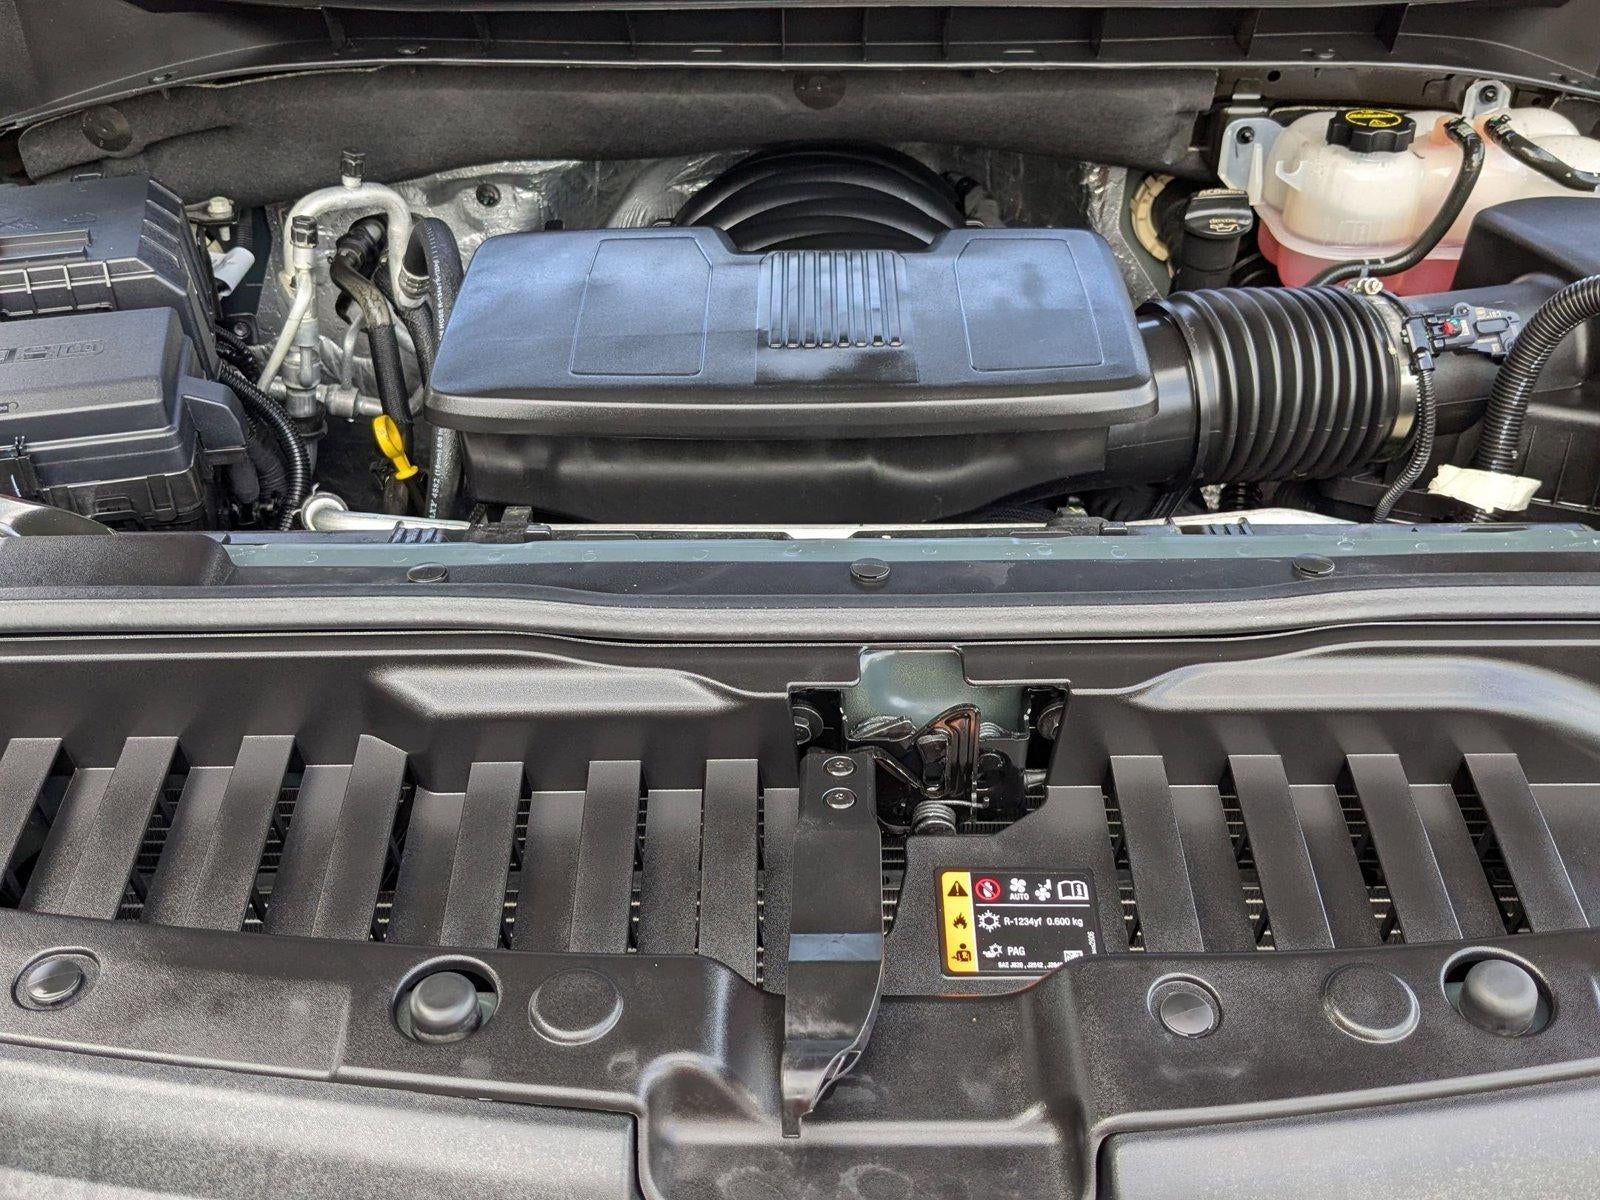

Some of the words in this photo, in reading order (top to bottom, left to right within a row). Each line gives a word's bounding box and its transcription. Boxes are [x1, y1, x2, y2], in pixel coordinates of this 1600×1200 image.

[1009, 892, 1030, 901] AUTO
[1003, 916, 1043, 928] R-1234yf
[1046, 916, 1071, 926] 0.600
[1071, 916, 1084, 928] kg
[1007, 946, 1026, 956] PAG
